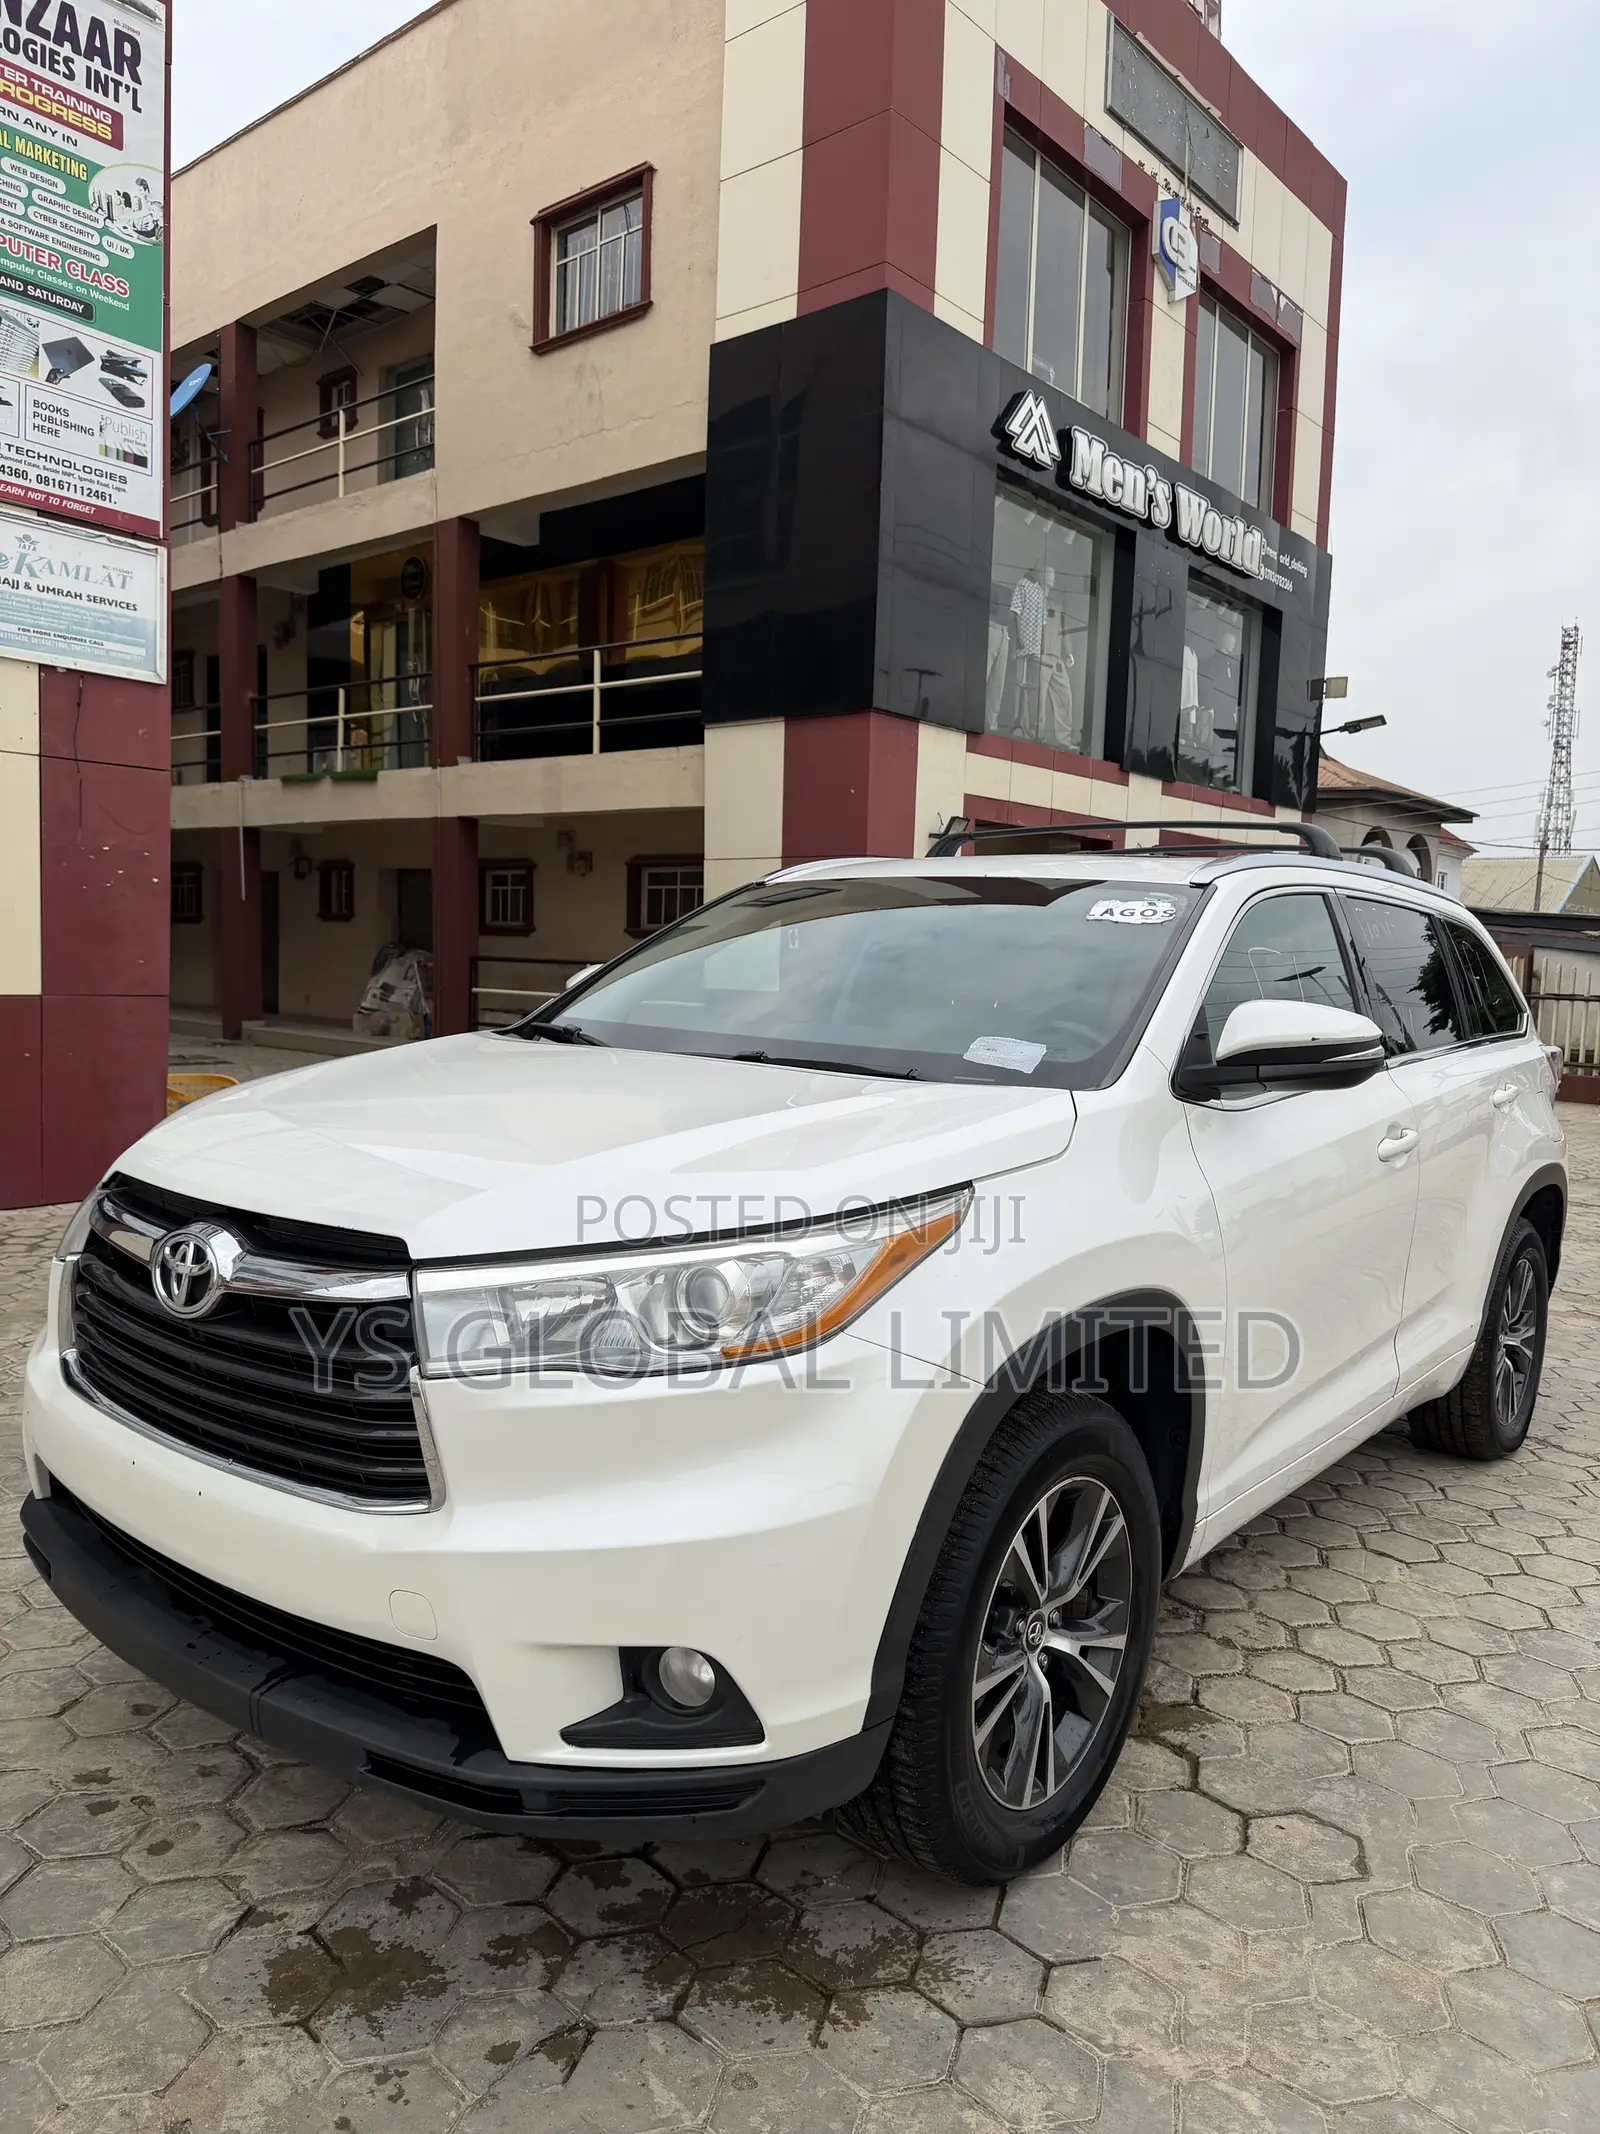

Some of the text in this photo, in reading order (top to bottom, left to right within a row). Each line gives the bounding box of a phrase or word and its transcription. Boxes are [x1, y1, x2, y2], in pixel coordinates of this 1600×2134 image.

[0, 27, 142, 114] OGIES INT'L
[0, 78, 113, 141] ROGRESS
[30, 77, 112, 125] TRAINING
[23, 117, 58, 138] ANY
[62, 133, 78, 147] IN
[15, 135, 88, 182] MARKETING
[10, 163, 59, 189] WEB DESIGN
[37, 193, 100, 224] GRAPHIC DESIGN
[8, 220, 50, 242] SOFTWARE
[52, 236, 101, 262] ENGINEERING
[33, 210, 95, 241] CYBER SECURITY
[106, 239, 114, 248] UI
[119, 245, 130, 255] UX
[0, 258, 130, 311] mputer Classes on Weekend
[65, 258, 130, 297] CLASS
[0, 275, 84, 314] AND SATURDAY
[33, 400, 70, 417] BOOKS
[33, 411, 95, 437] PUBLISHING
[33, 423, 61, 438] HERE
[104, 416, 147, 442] Publish
[5, 442, 128, 485] TECHNOLOGIES
[27, 490, 46, 502] NOT
[48, 496, 60, 506] TO
[62, 500, 96, 515] FORGET
[36, 474, 117, 505] 08167112461.
[1071, 426, 1264, 580] Men's World
[12, 551, 133, 590] KAMLAT
[0, 577, 19, 590] AJJ
[24, 581, 32, 590] &
[37, 584, 83, 602] UMRAH
[86, 594, 138, 611] SERVICES
[1088, 908, 1176, 917] AGOS
